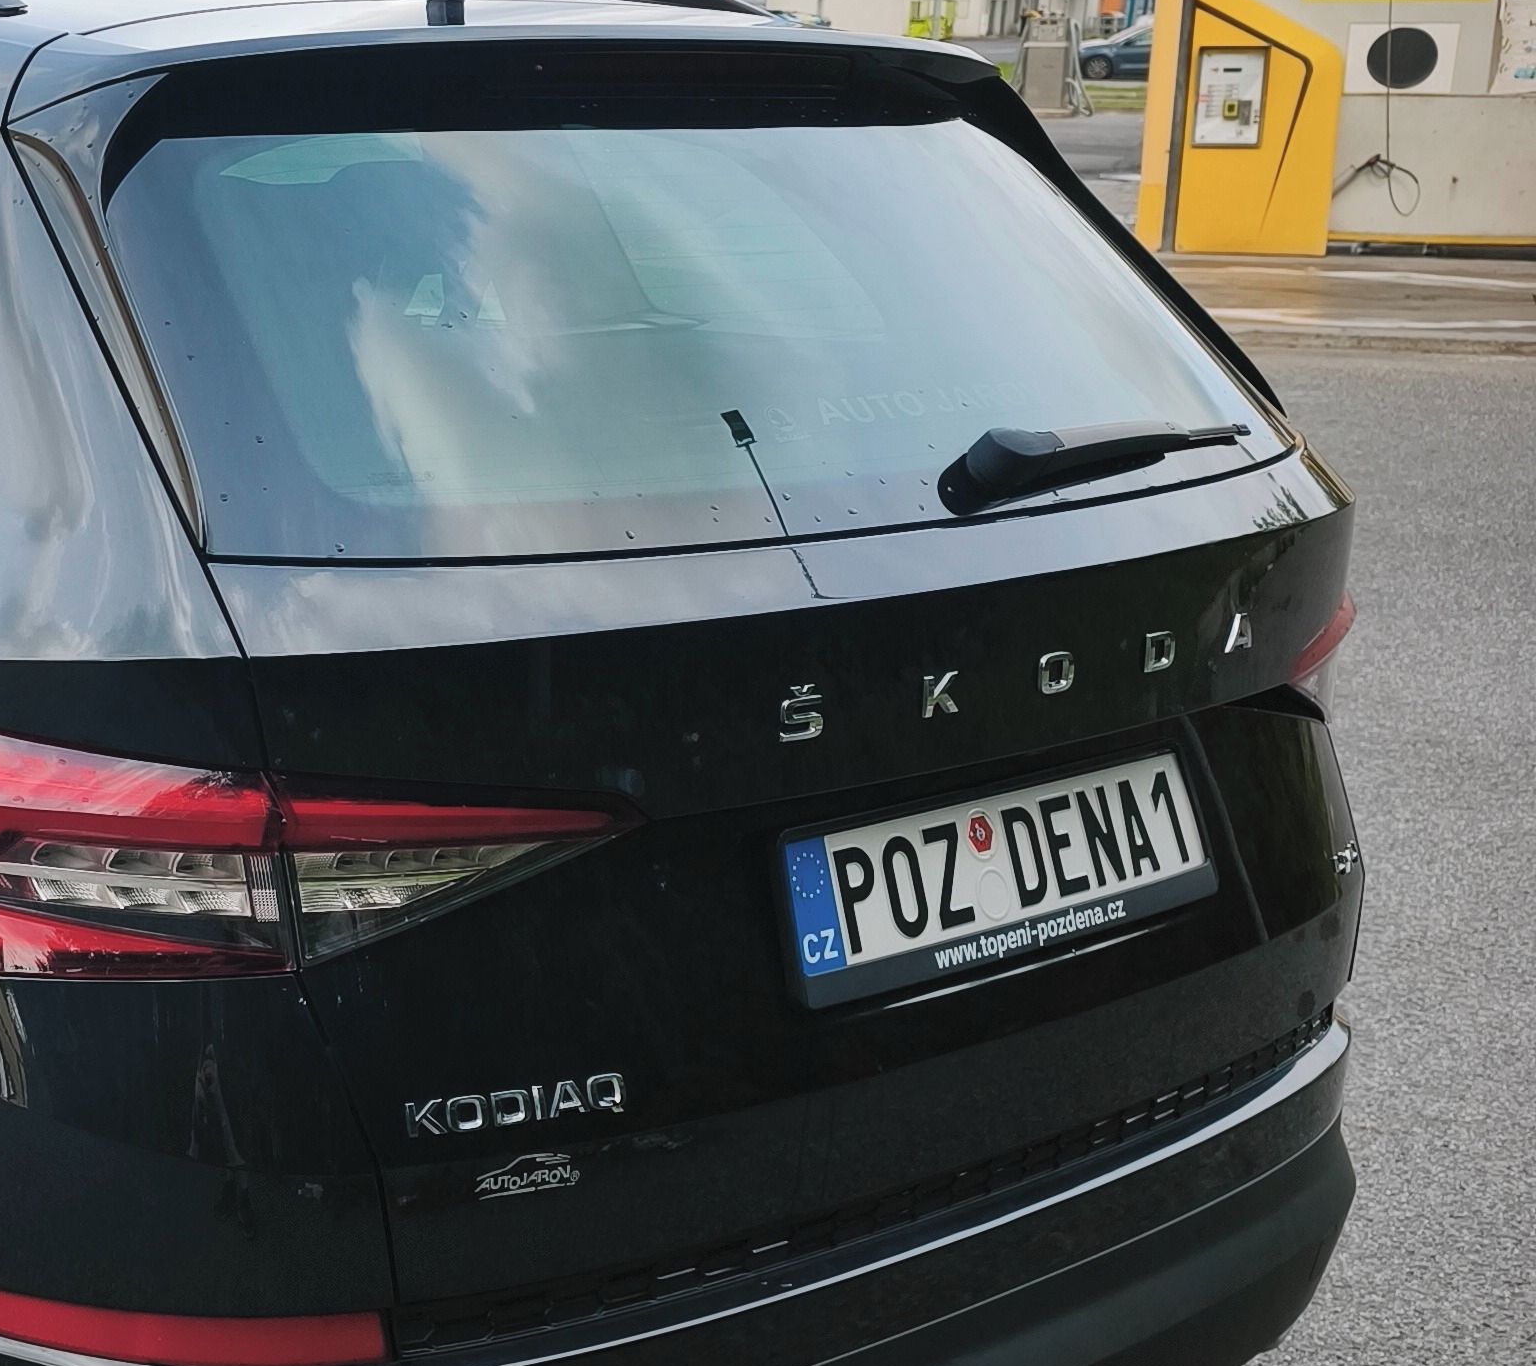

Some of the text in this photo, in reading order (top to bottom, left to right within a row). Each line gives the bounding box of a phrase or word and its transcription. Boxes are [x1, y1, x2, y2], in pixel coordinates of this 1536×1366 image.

[815, 389, 925, 426] AUTO
[779, 612, 1253, 742] ŠKODA
[833, 771, 1190, 955] POZ DENA1
[802, 927, 839, 964] CZ
[934, 898, 1127, 970] www.topeni-pozdena.cz
[404, 1072, 626, 1138] KODIAQ
